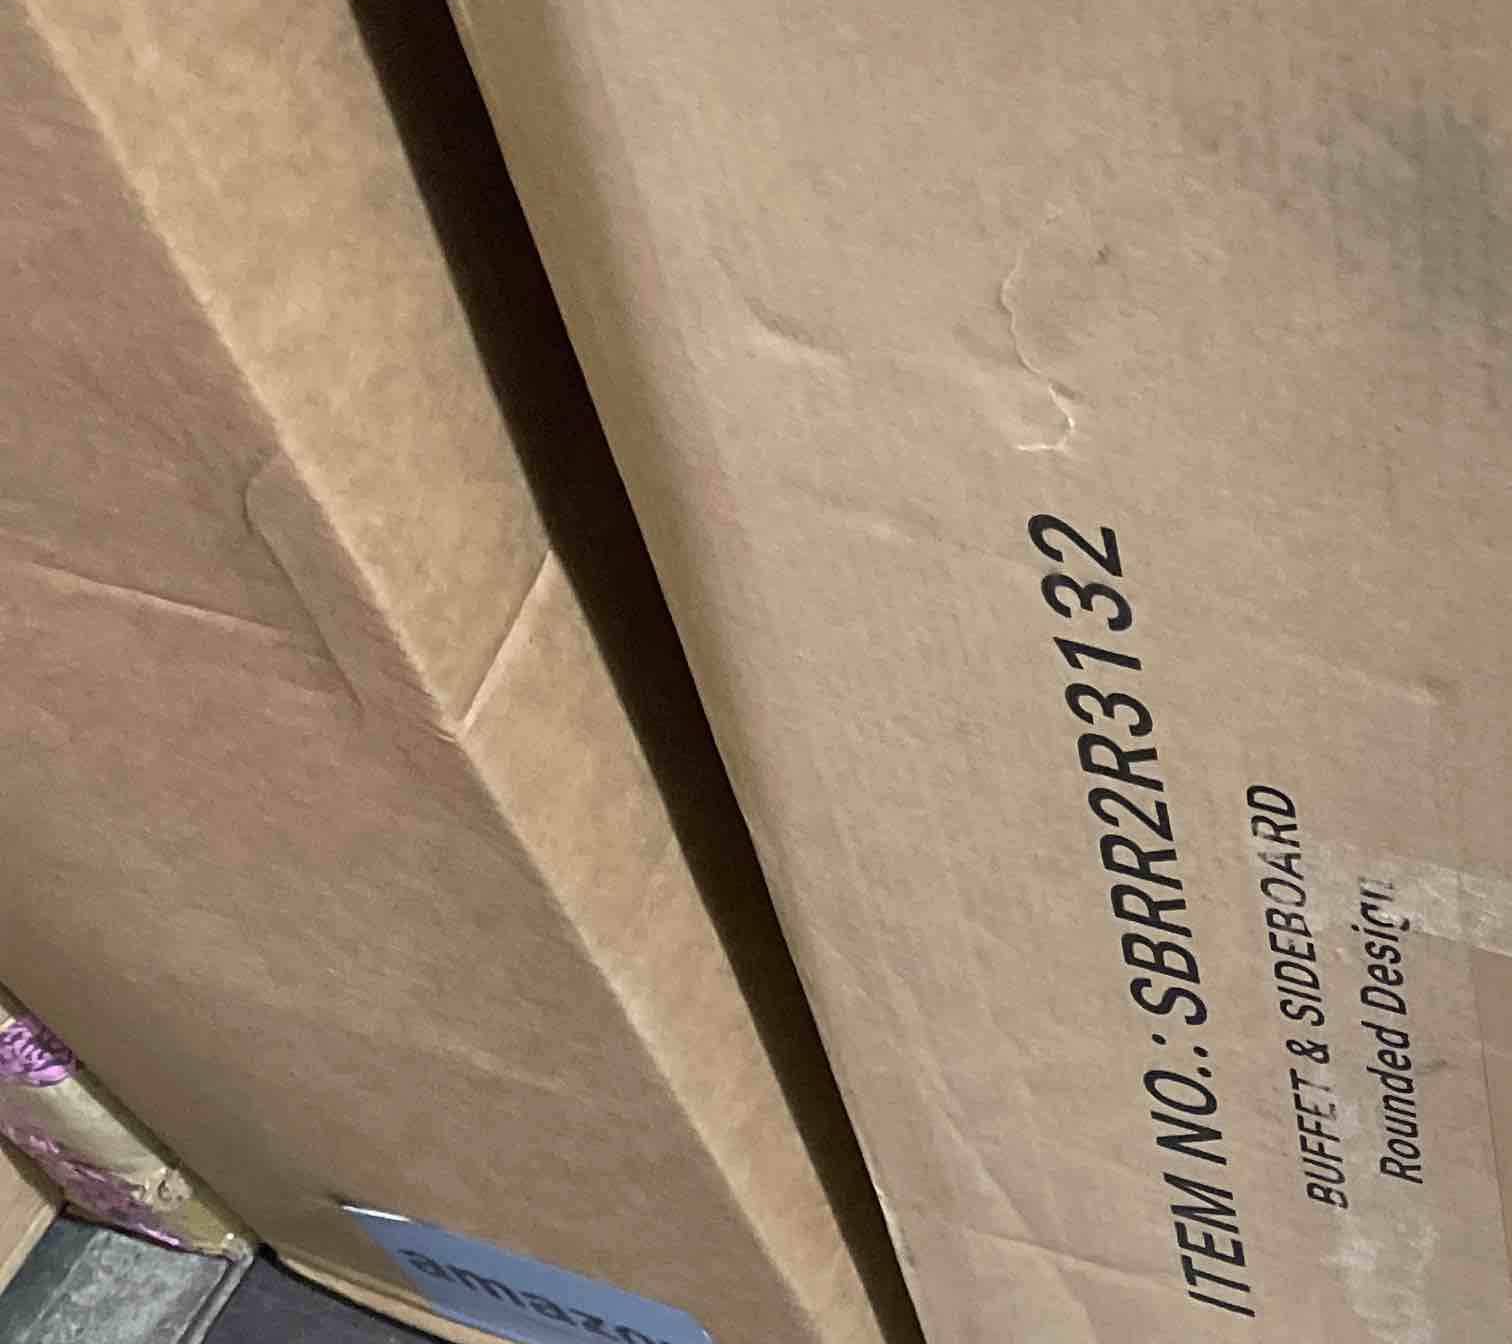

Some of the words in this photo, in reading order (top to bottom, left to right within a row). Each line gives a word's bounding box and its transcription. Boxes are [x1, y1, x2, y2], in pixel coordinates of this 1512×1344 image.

[1028, 514, 1208, 1025] SBRR2R3132
[1246, 785, 1326, 1027] SIDEBOARD
[1143, 1034, 1227, 1165] NO.:
[1285, 1038, 1331, 1065] &
[1361, 1020, 1424, 1185] Rounded
[1289, 1068, 1349, 1210] BUFFET
[1163, 1172, 1256, 1318] ITEM
